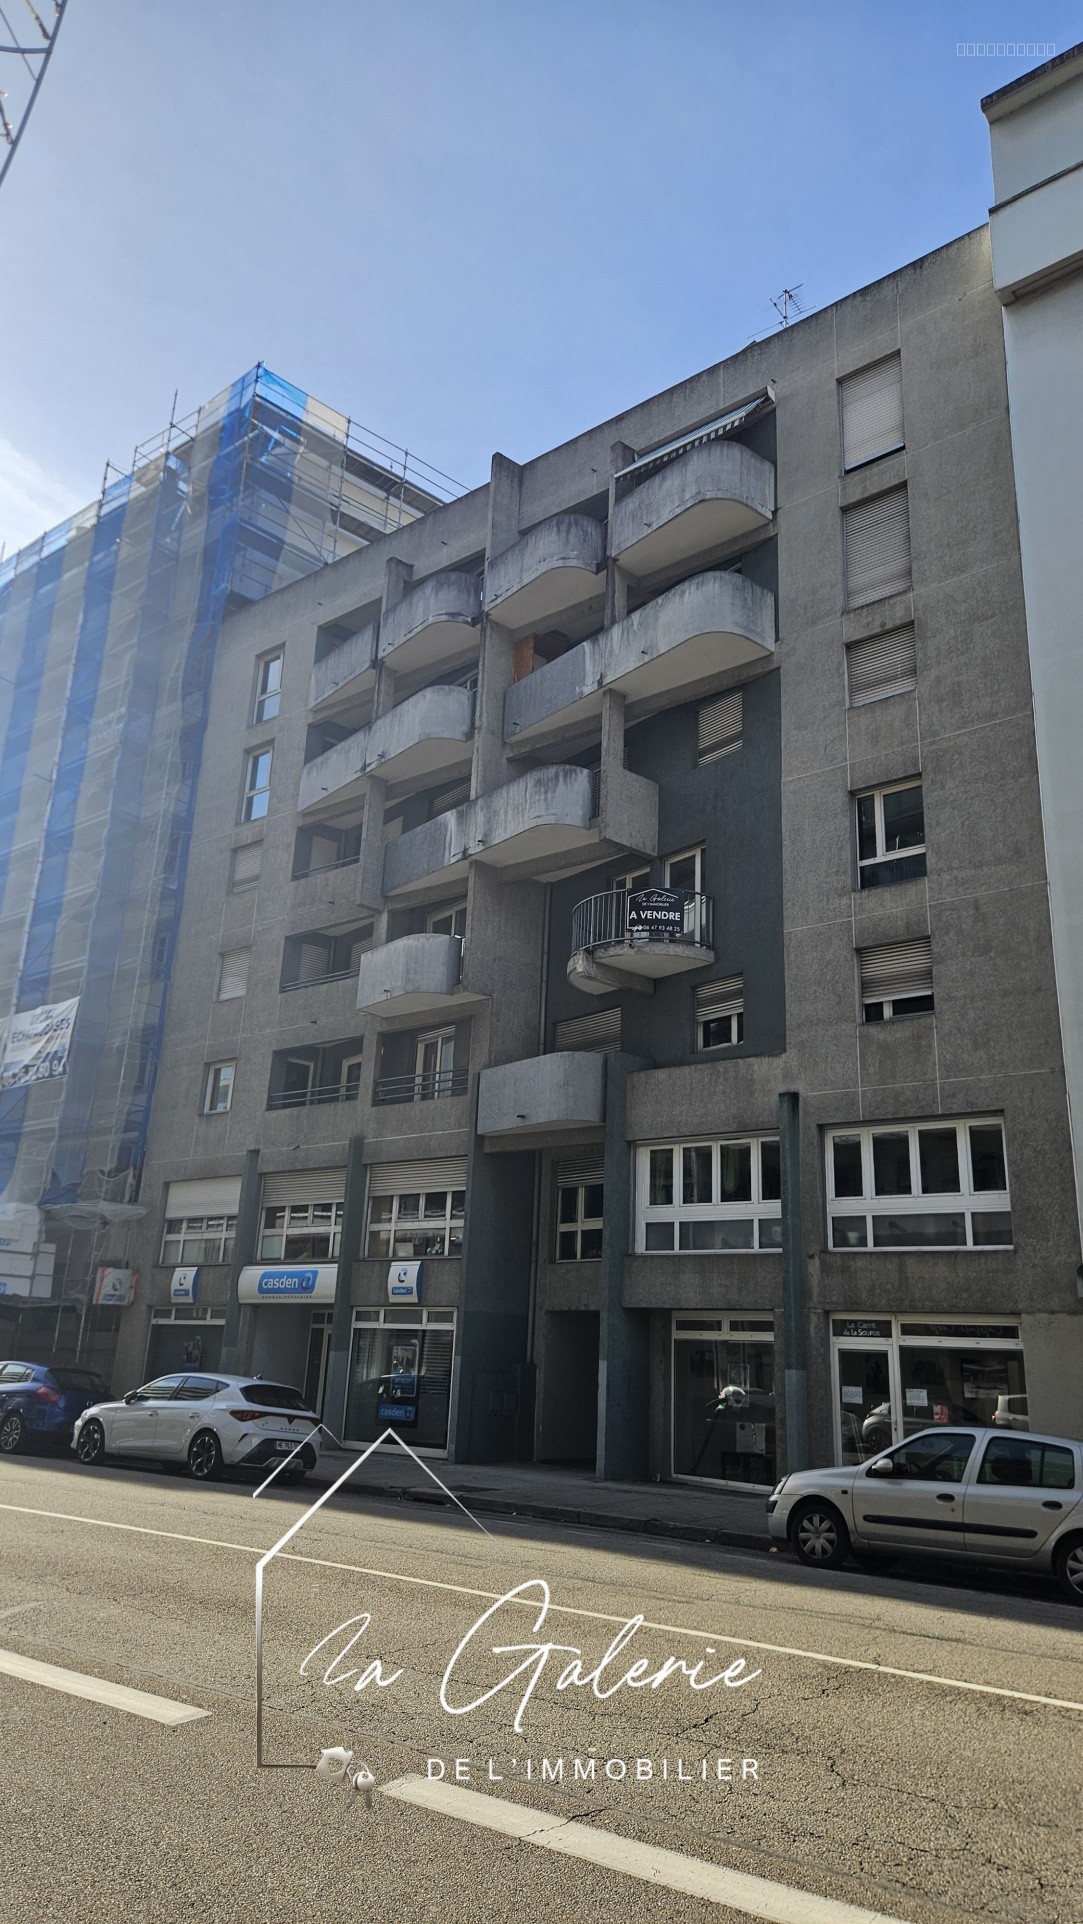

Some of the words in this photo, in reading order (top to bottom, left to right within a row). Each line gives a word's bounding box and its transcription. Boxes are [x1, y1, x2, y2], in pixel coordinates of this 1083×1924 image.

[630, 911, 637, 919] A
[640, 911, 680, 920] VENDRE
[262, 1276, 298, 1288] casden
[380, 1405, 404, 1416] casden
